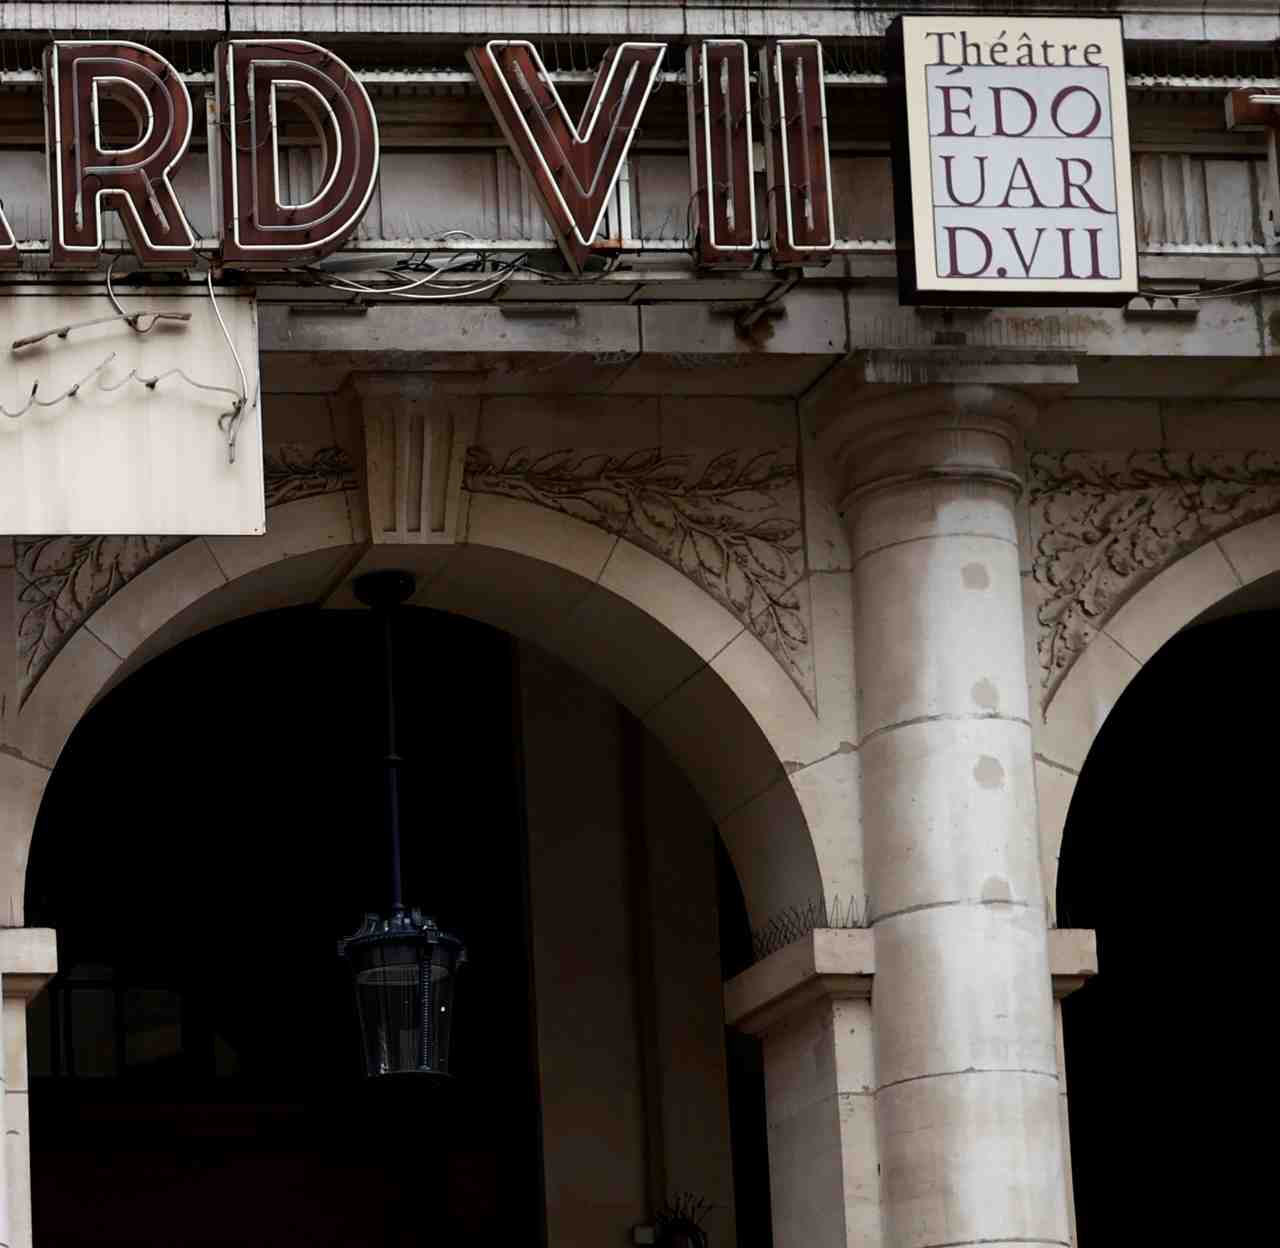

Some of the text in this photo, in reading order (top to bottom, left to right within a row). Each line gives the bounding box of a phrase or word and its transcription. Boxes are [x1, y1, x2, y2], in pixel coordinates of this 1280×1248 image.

[925, 30, 1104, 67] Théâtre
[934, 66, 1103, 138] ÉDO
[465, 39, 836, 274] VII
[939, 154, 1117, 215] UAR
[942, 225, 1109, 280] D.VII
